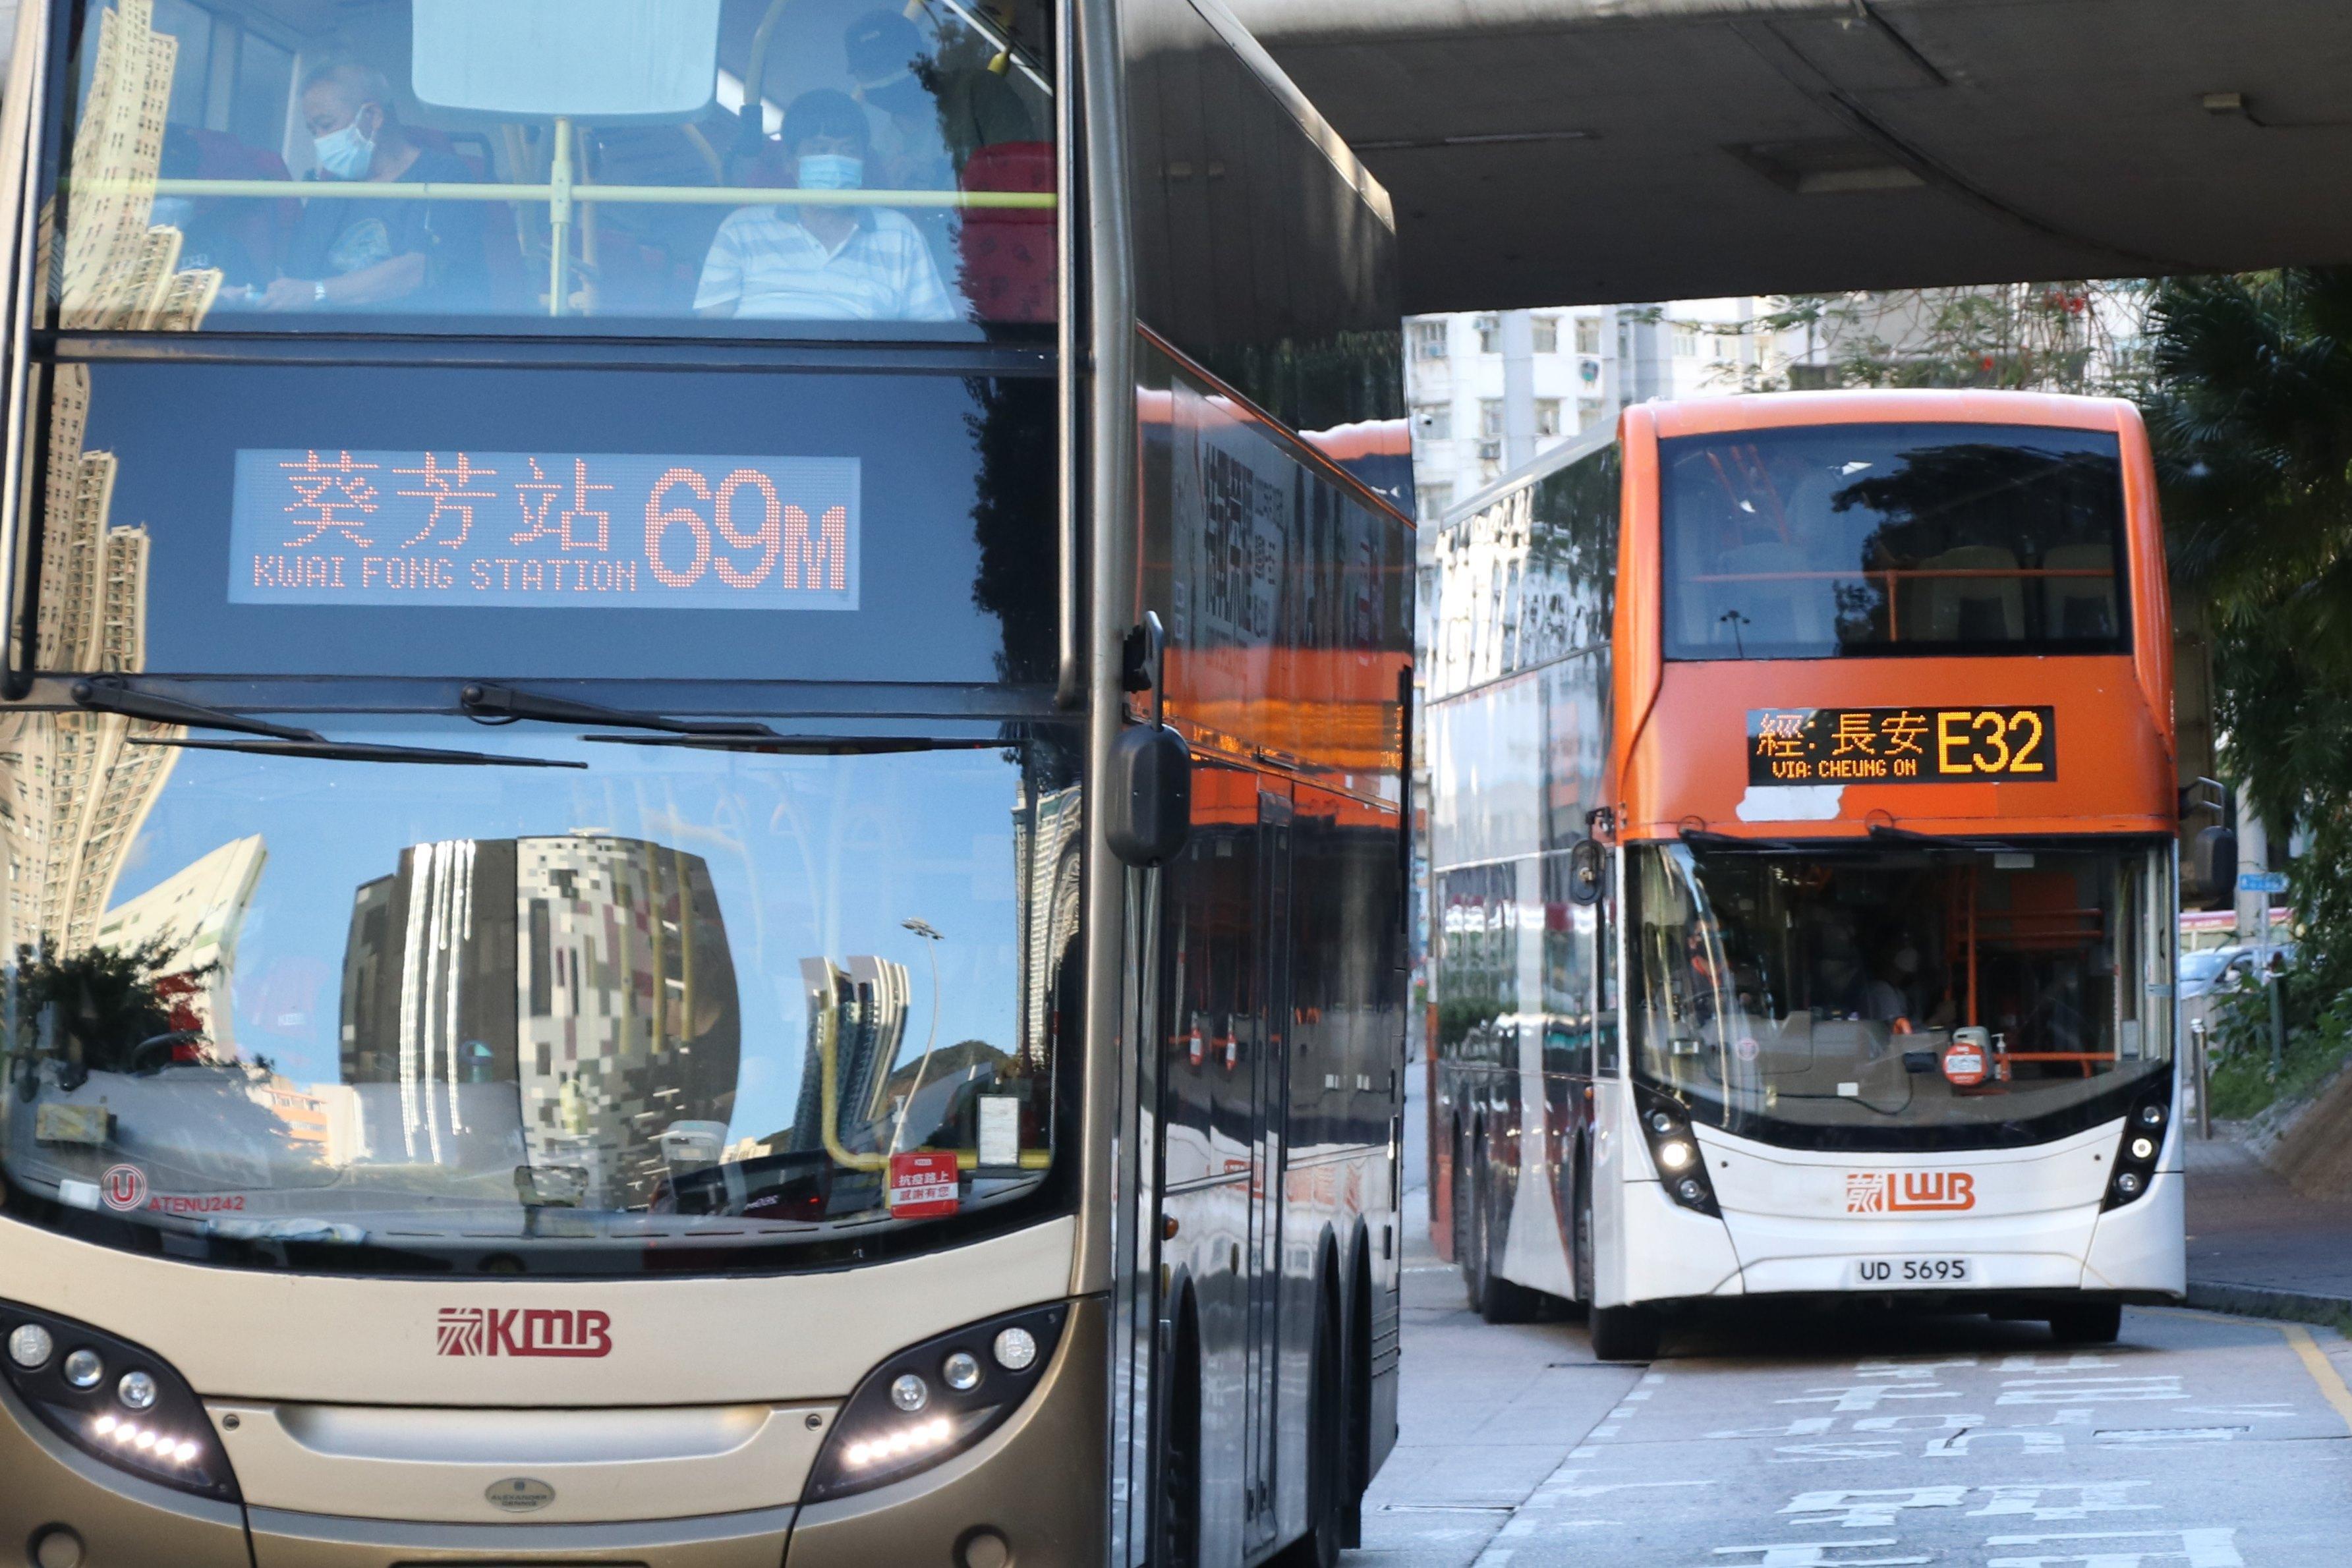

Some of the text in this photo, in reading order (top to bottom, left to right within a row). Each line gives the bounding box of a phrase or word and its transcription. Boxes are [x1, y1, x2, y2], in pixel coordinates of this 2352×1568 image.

[280, 450, 614, 550] 葵芳站
[645, 467, 847, 589] 69M
[254, 554, 637, 592] KWAI FONG STATION
[1937, 710, 2044, 775] E32
[1772, 759, 1918, 779] VIA: CHEUNG ON
[147, 1195, 245, 1213] ATENU242
[1887, 1172, 1976, 1212] LWB
[1860, 1260, 1966, 1280] UD 5695
[486, 1308, 613, 1358] KMB
